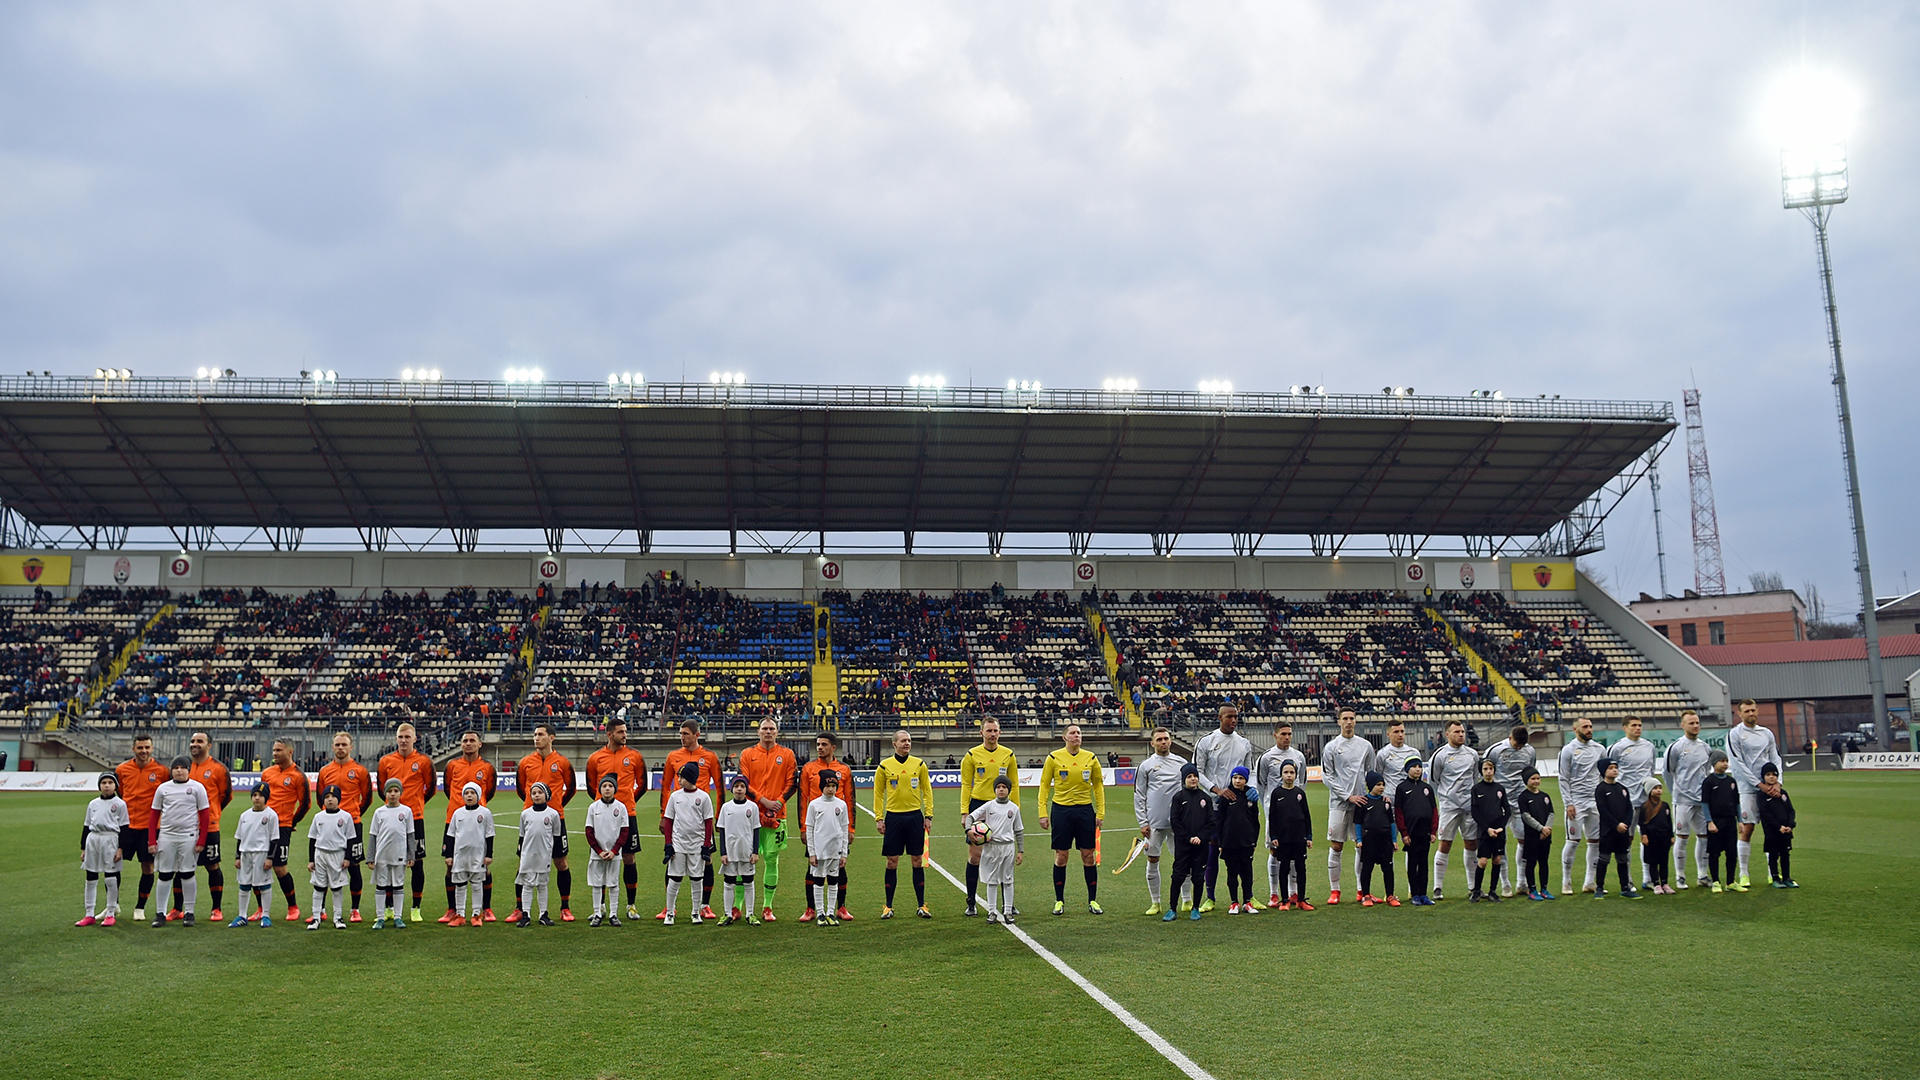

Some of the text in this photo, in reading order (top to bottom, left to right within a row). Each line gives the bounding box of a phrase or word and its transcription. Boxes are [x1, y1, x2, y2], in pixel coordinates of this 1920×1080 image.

[175, 561, 185, 573] 9
[542, 563, 556, 575] 10
[824, 564, 837, 576] 11
[1079, 565, 1092, 577] 12
[1409, 566, 1421, 578] 13
[206, 844, 219, 858] 31
[351, 842, 363, 857] 50
